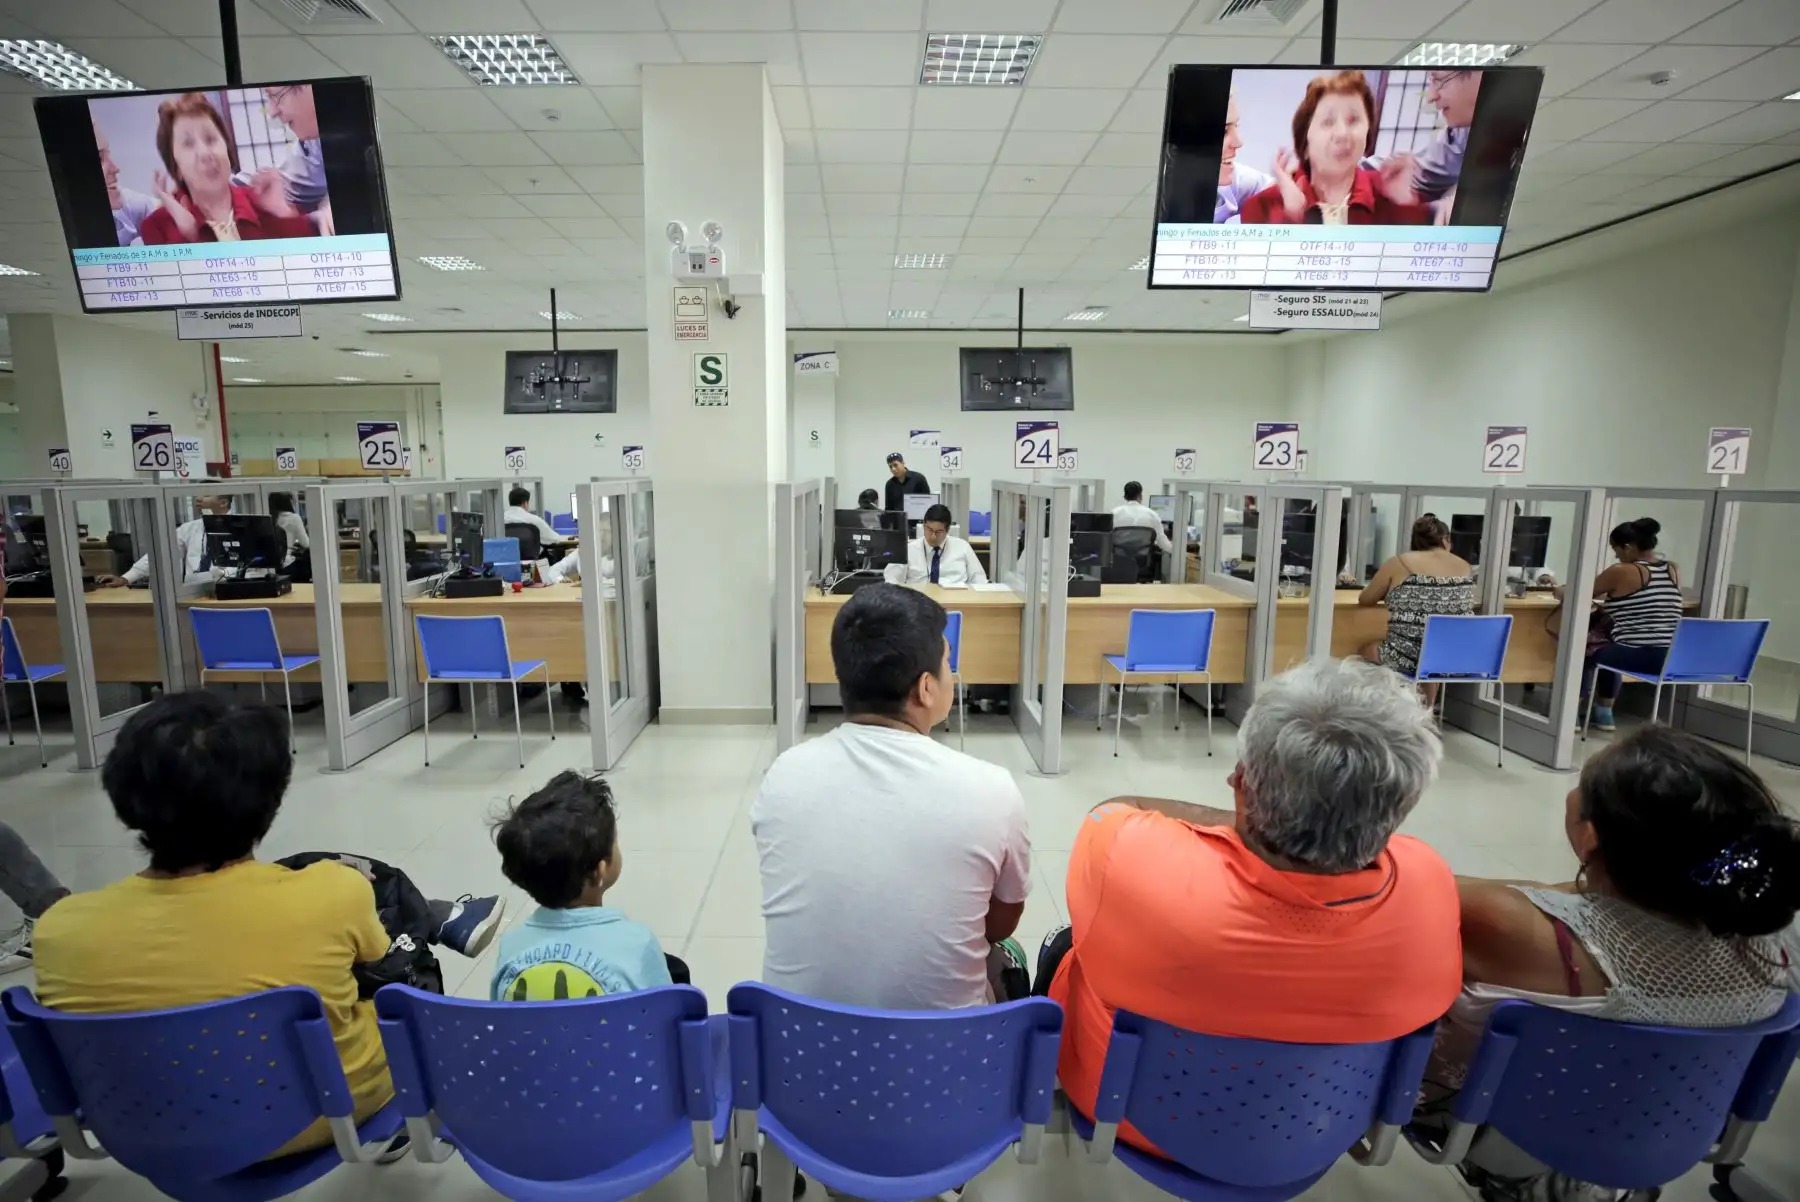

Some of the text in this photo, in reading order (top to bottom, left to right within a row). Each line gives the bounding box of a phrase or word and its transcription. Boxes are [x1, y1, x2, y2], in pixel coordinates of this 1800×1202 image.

[1221, 229, 1232, 237] de
[1233, 229, 1239, 237] 9
[130, 251, 140, 260] de
[141, 251, 147, 259] 9
[1274, 294, 1310, 306] -Seguro
[1312, 294, 1327, 303] SIS
[1359, 298, 1369, 306] 23)
[200, 307, 299, 321] -Servicios de INDECOPI
[1273, 307, 1309, 318] -Seguro
[228, 322, 254, 330] (mód 25)
[700, 355, 723, 385] S
[800, 361, 830, 371] ZONA C
[810, 430, 819, 441] S
[138, 441, 170, 467] 26
[364, 440, 398, 466] 25
[1020, 439, 1053, 465] 24
[1258, 440, 1292, 466] 23
[1488, 443, 1520, 468] 22
[1711, 446, 1740, 470] 21
[52, 456, 69, 470] 40
[279, 455, 296, 470] 38
[508, 455, 524, 468] 36
[625, 454, 642, 467] 35
[943, 455, 960, 468] 34
[1059, 456, 1075, 469] 33
[1176, 457, 1193, 470] 32
